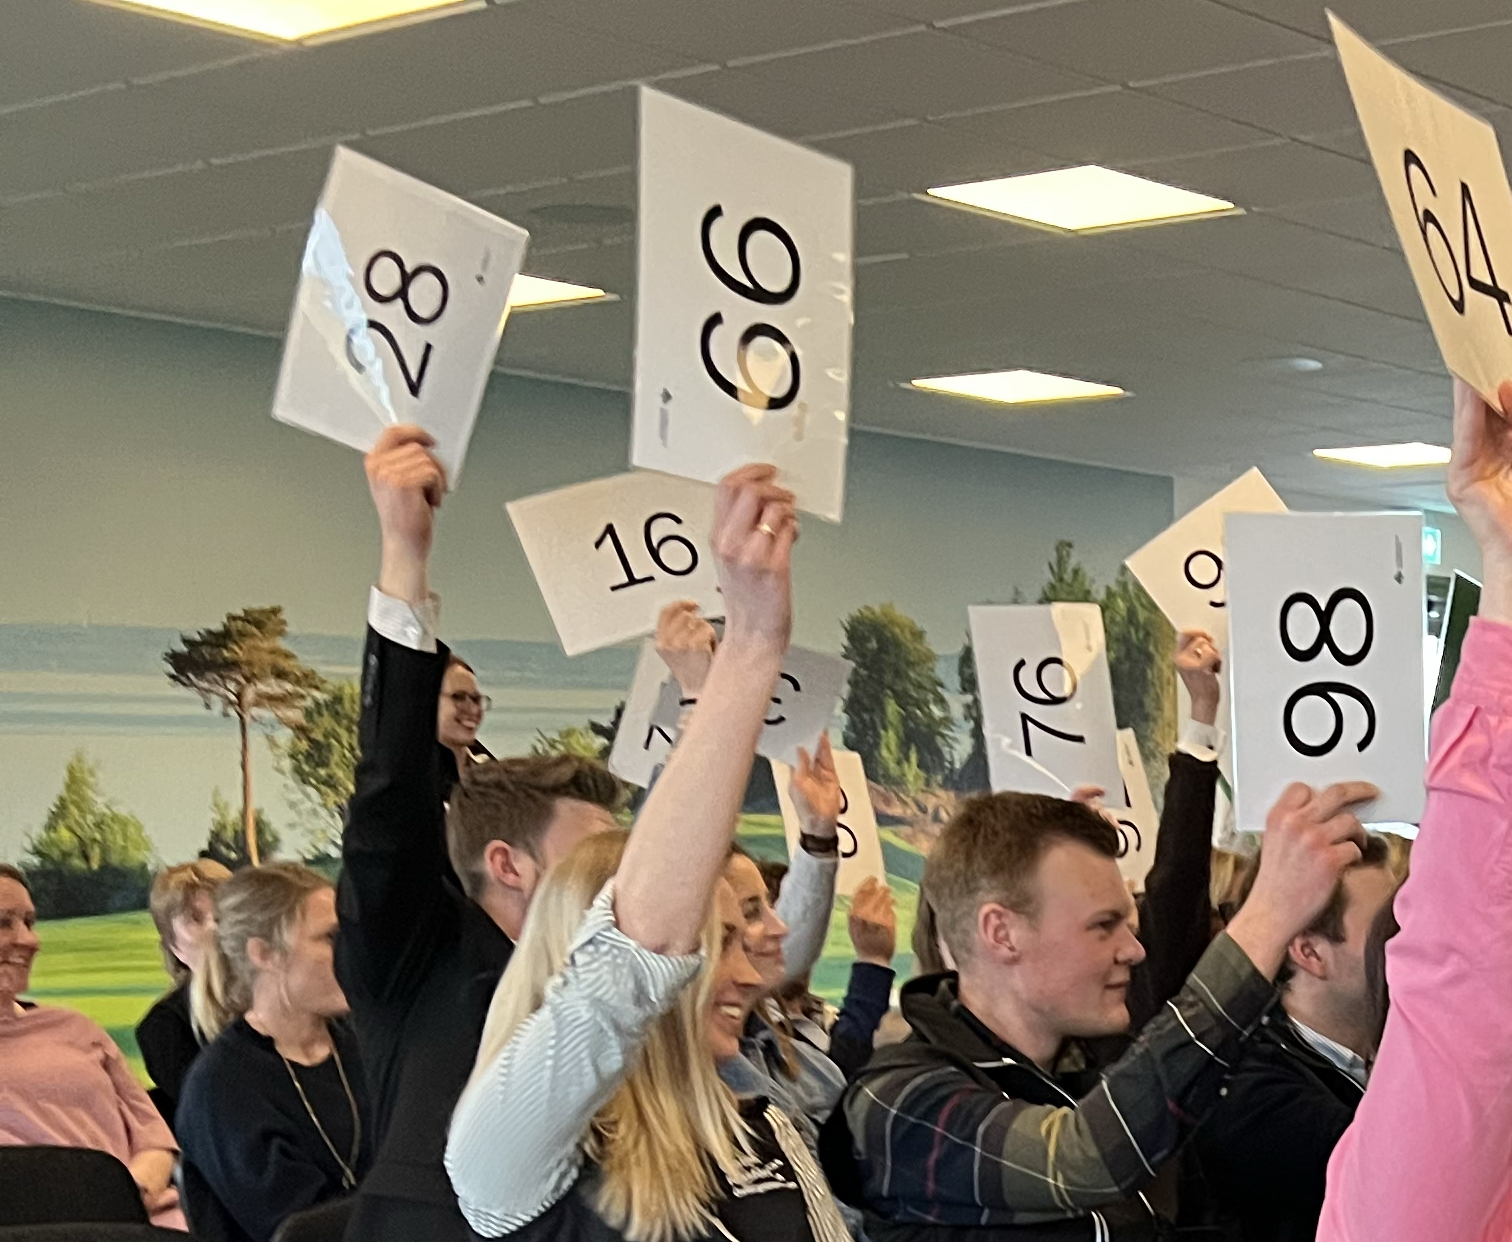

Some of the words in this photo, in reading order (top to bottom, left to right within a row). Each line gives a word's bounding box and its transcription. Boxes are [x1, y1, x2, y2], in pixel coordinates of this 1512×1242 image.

[346, 248, 449, 398] 28
[593, 511, 699, 592] 16
[1012, 655, 1085, 757] 76
[1279, 586, 1376, 757] 98
